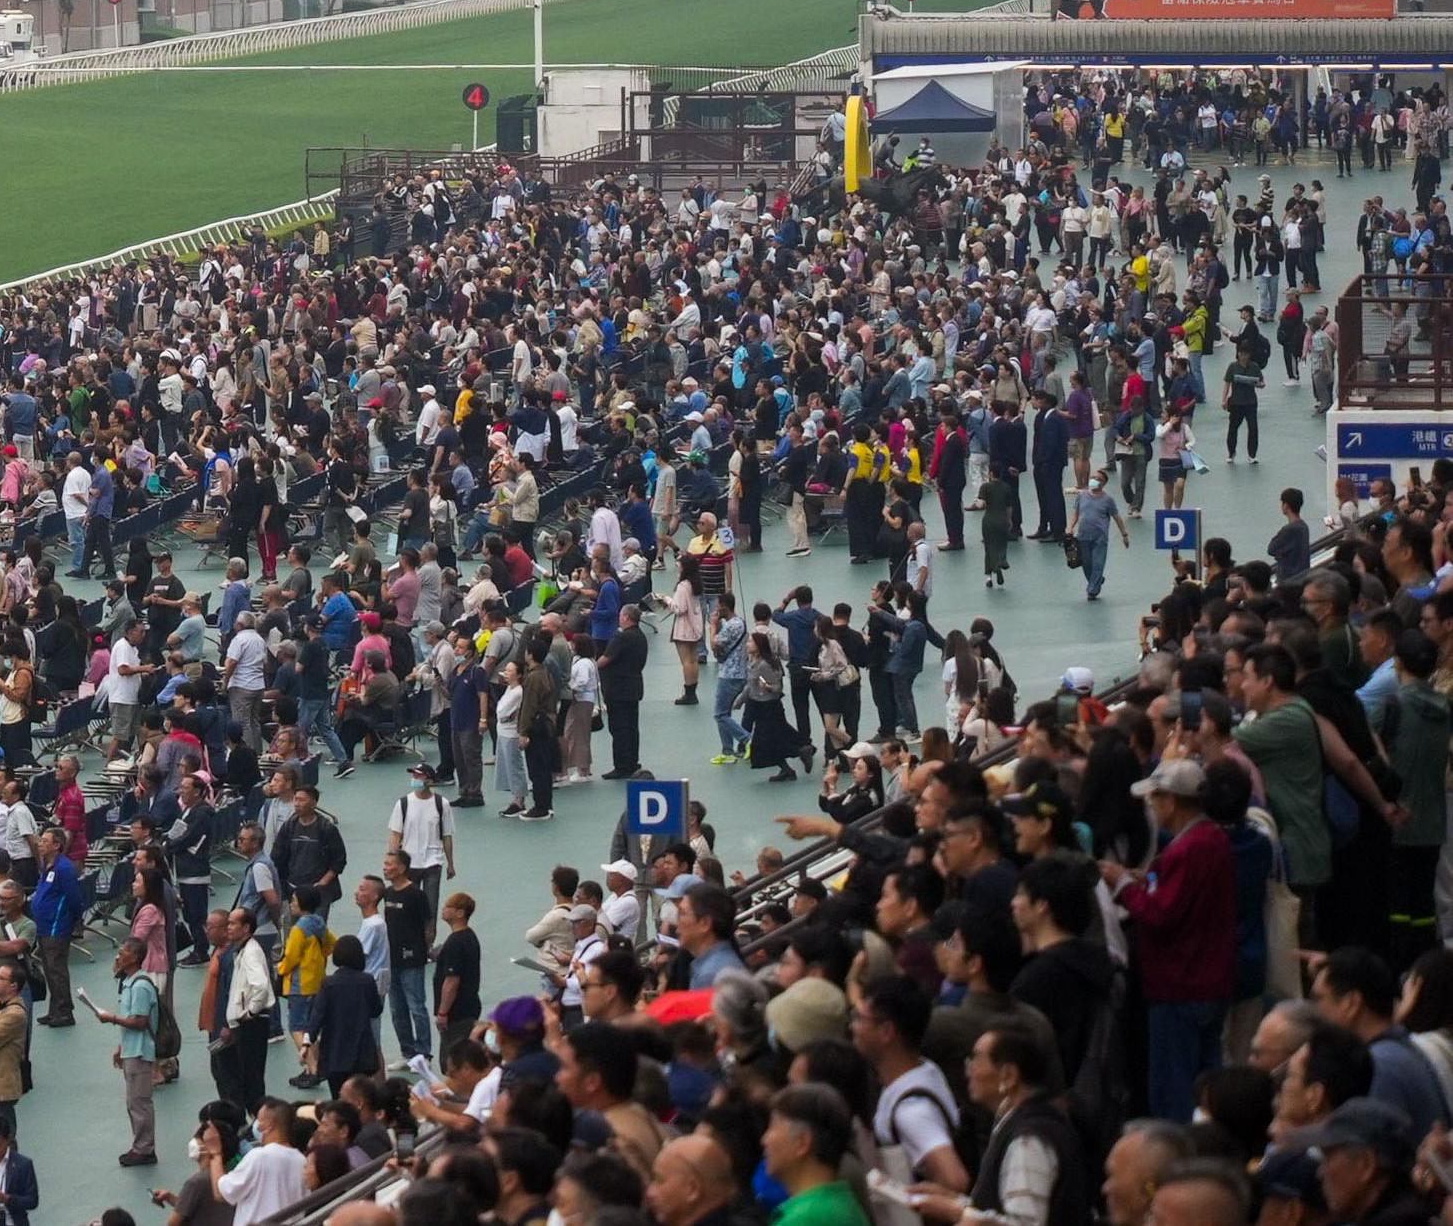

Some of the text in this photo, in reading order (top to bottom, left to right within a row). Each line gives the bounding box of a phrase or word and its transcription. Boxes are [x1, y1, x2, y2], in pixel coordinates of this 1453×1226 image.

[467, 87, 483, 106] 4
[1163, 518, 1185, 543] D
[638, 790, 669, 825] D
